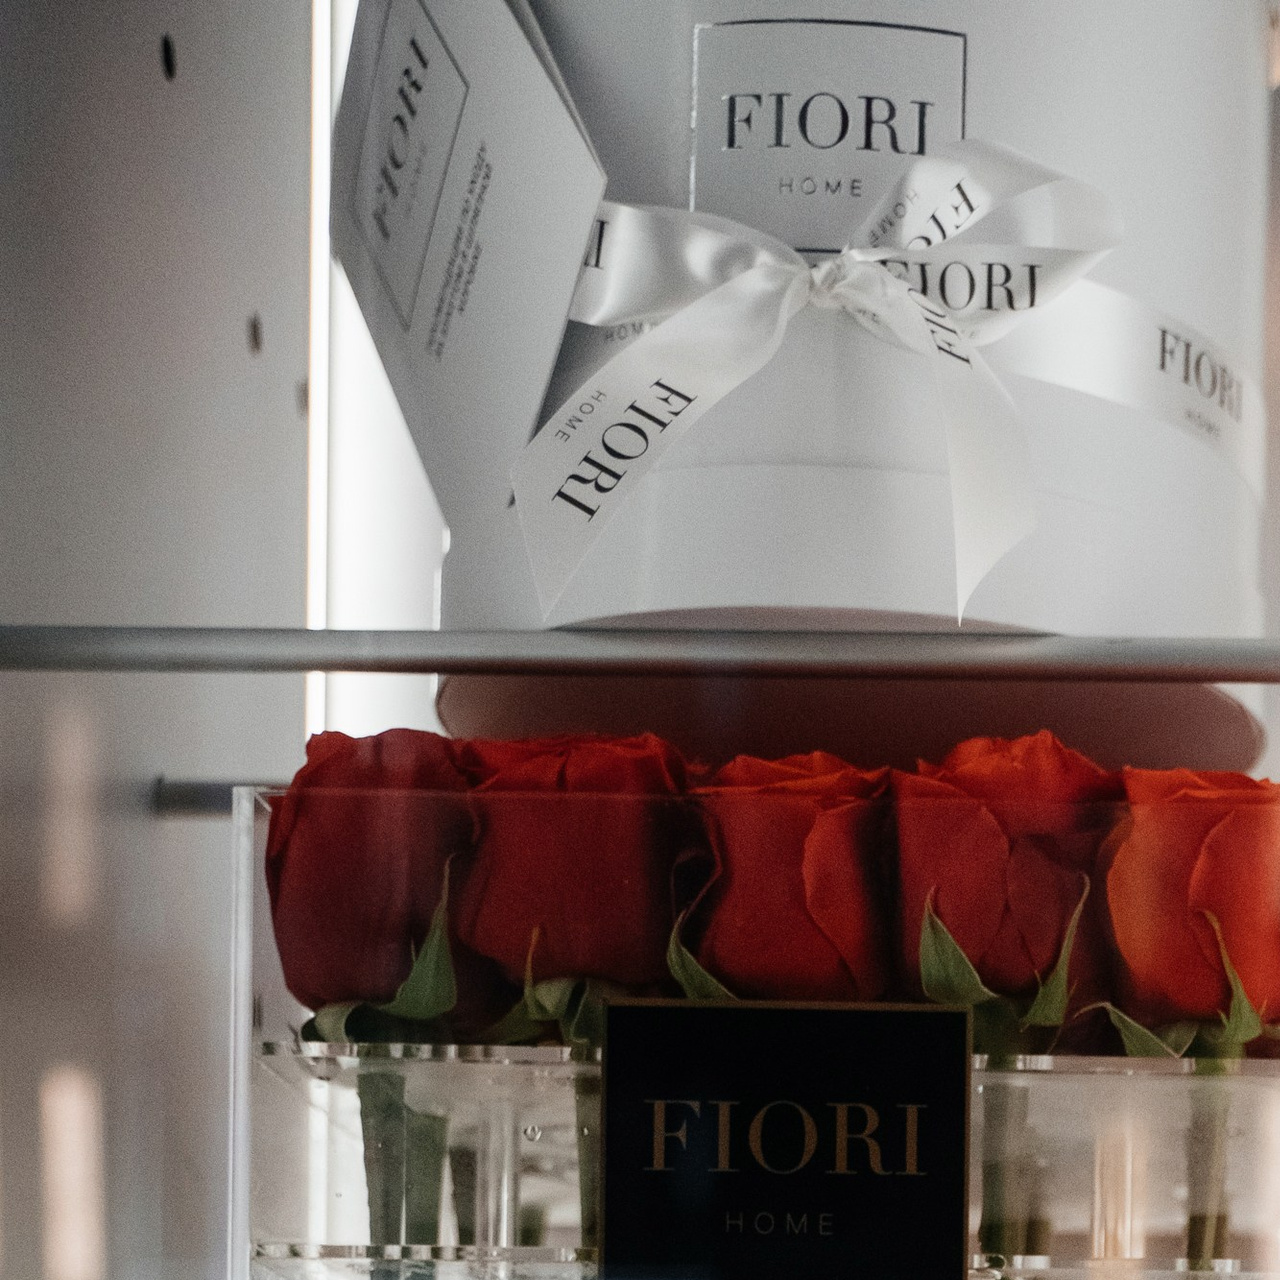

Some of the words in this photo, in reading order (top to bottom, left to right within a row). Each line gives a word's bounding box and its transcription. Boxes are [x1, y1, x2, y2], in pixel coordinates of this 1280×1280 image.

[724, 92, 935, 157] FIORI
[778, 177, 864, 198] HOME
[554, 390, 607, 443] HOME
[552, 378, 698, 522] FIORI
[643, 1099, 928, 1176] FIORI
[725, 1212, 835, 1236] HOME
